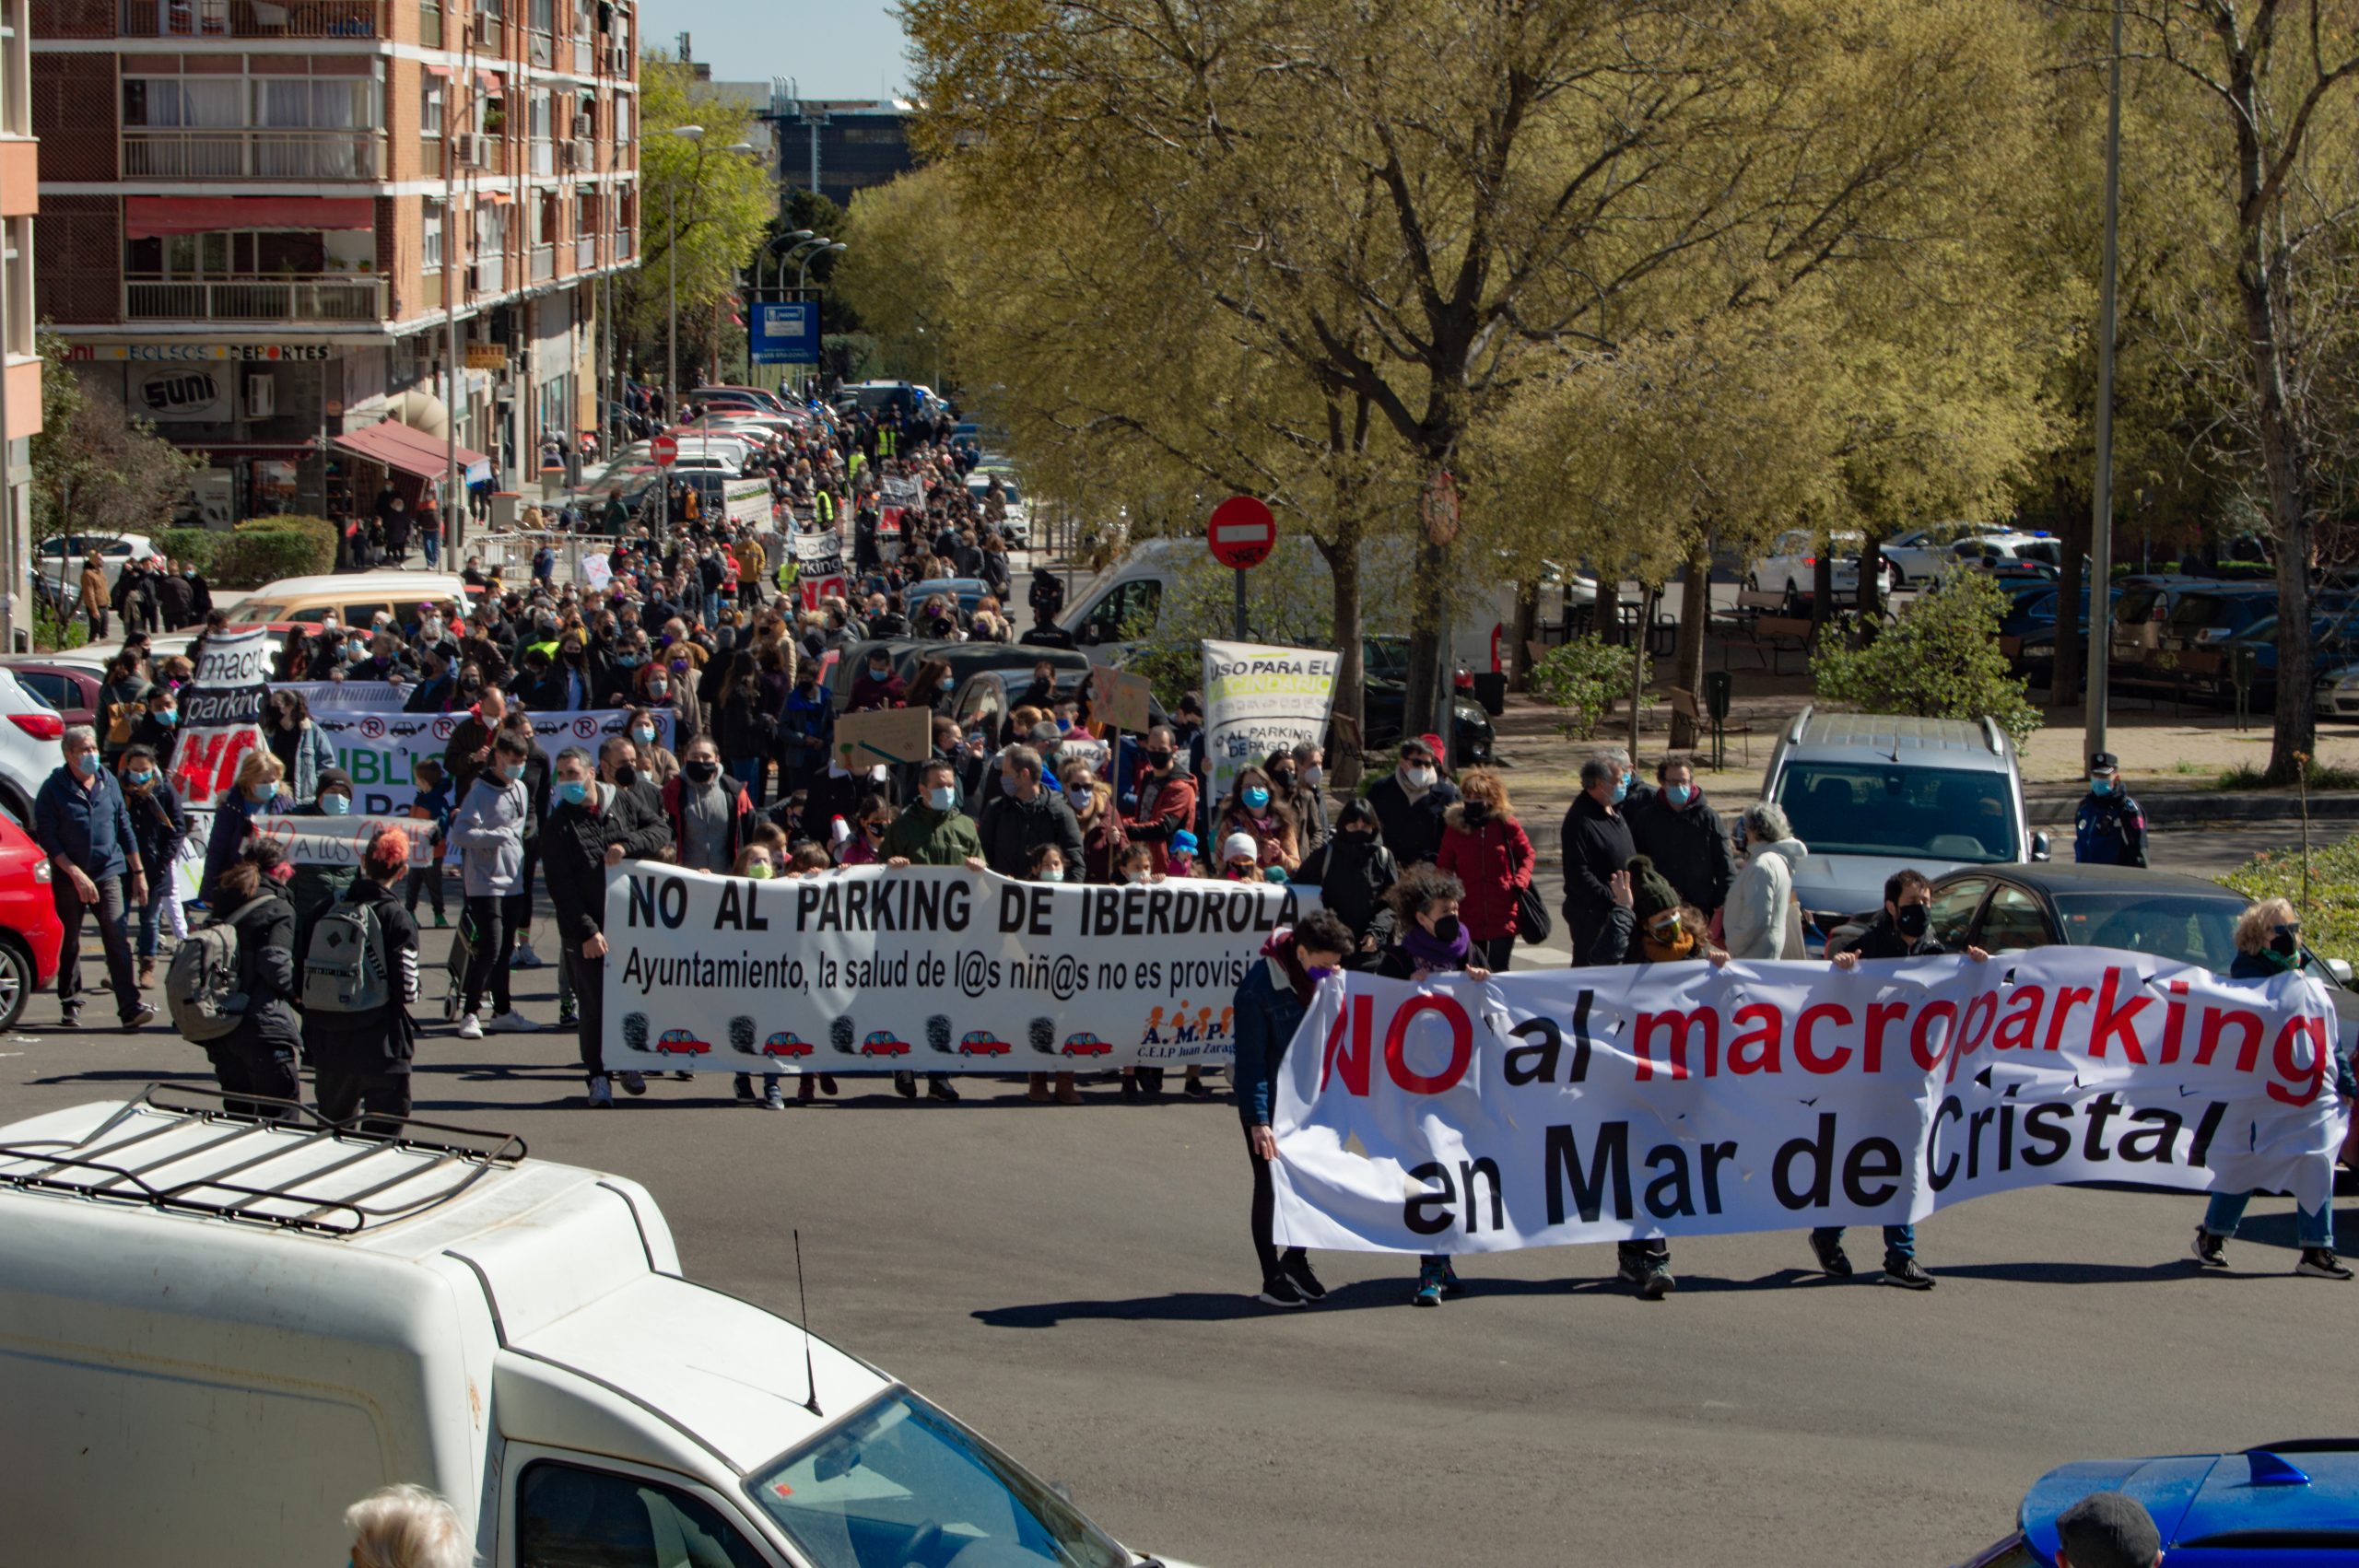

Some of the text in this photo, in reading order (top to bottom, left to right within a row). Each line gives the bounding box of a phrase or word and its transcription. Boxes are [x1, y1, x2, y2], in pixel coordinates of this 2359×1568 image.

[129, 345, 208, 360] BOLSOS
[230, 345, 328, 360] DEPORTES
[796, 539, 838, 556] acro
[802, 558, 842, 575] rking
[1251, 661, 1303, 674] PARA
[1309, 660, 1332, 676] EL
[1218, 675, 1332, 693] CINDARIO
[1227, 730, 1246, 742] AL
[1250, 726, 1313, 741] PARKING
[1229, 741, 1290, 757] DE PAGO
[295, 837, 311, 859] A
[319, 837, 350, 862] LOS
[628, 875, 1299, 936] NO AL PARKING DE IBERDROLA
[623, 946, 1250, 1001] Ayuntamiento, la salud de l@s niñ@s no es provisi
[1141, 1023, 1235, 1045] A.M.P.
[1320, 965, 2327, 1107] NO al macroparking
[1178, 1046, 1201, 1058] Juan
[1203, 1043, 1235, 1055] Zarag
[1402, 1082, 2229, 1235] en Mar de Cristal
